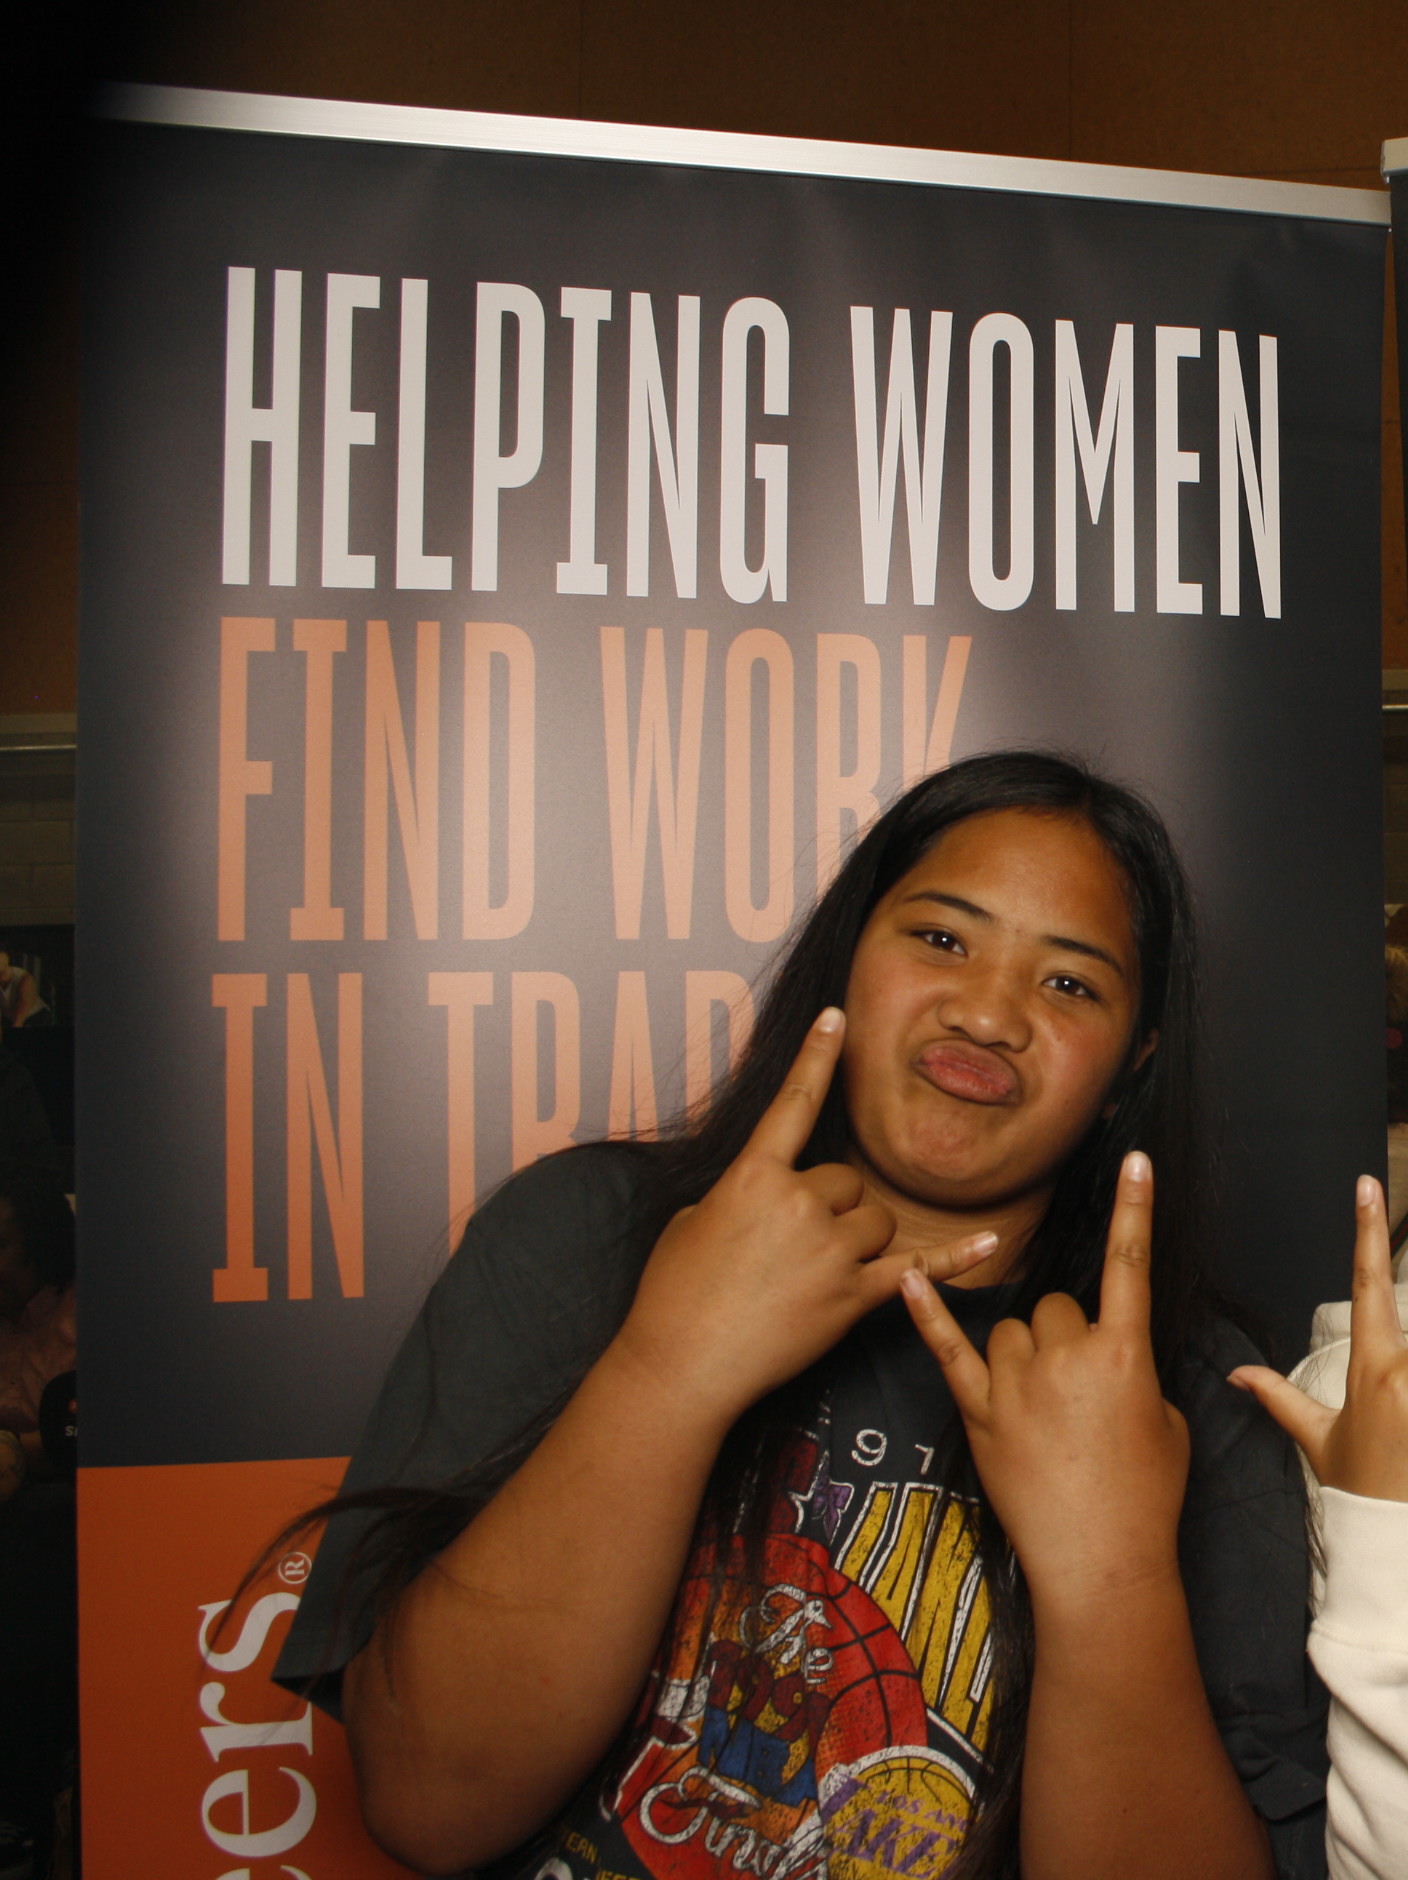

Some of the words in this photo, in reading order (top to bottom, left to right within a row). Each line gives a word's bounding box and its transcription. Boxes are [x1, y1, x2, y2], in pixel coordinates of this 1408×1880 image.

[222, 266, 790, 602] HELPING
[850, 305, 1282, 619] WOMEN
[218, 616, 537, 941] FIND
[211, 972, 364, 1302] IN
